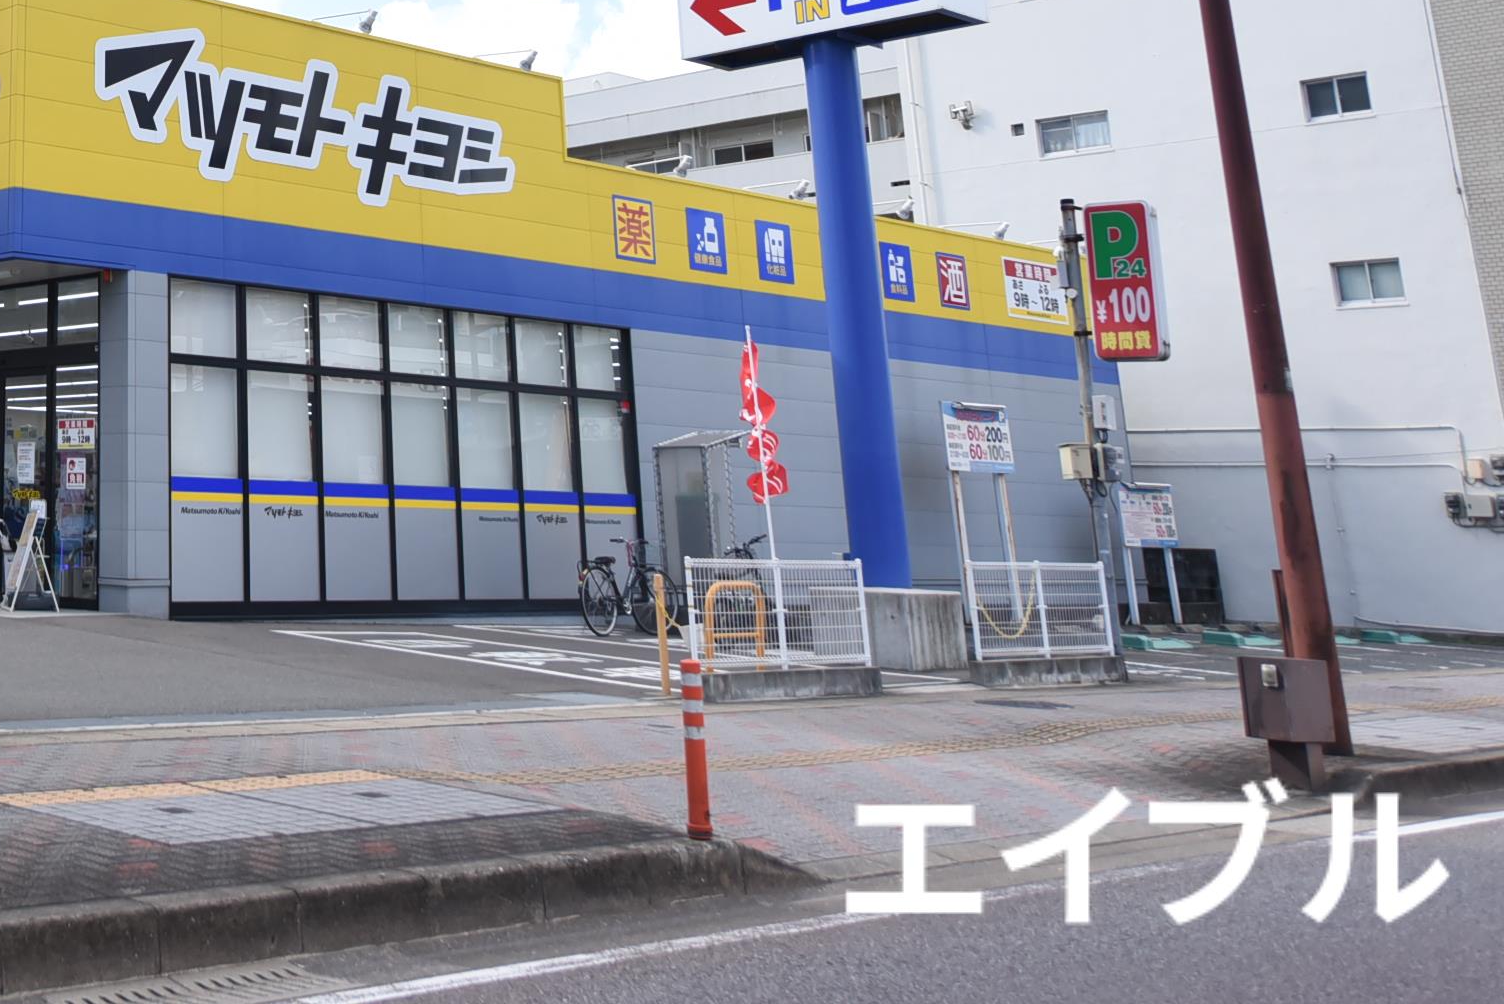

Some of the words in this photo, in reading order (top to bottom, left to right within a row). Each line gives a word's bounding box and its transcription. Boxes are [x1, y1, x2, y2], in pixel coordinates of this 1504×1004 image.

[103, 39, 509, 196] マツモトキヨシ
[617, 202, 652, 258] 薬
[938, 258, 967, 304] 酒
[1100, 330, 1152, 352] 時間貸
[180, 506, 218, 515] Matsumoto
[325, 510, 359, 519] Matsumoto
